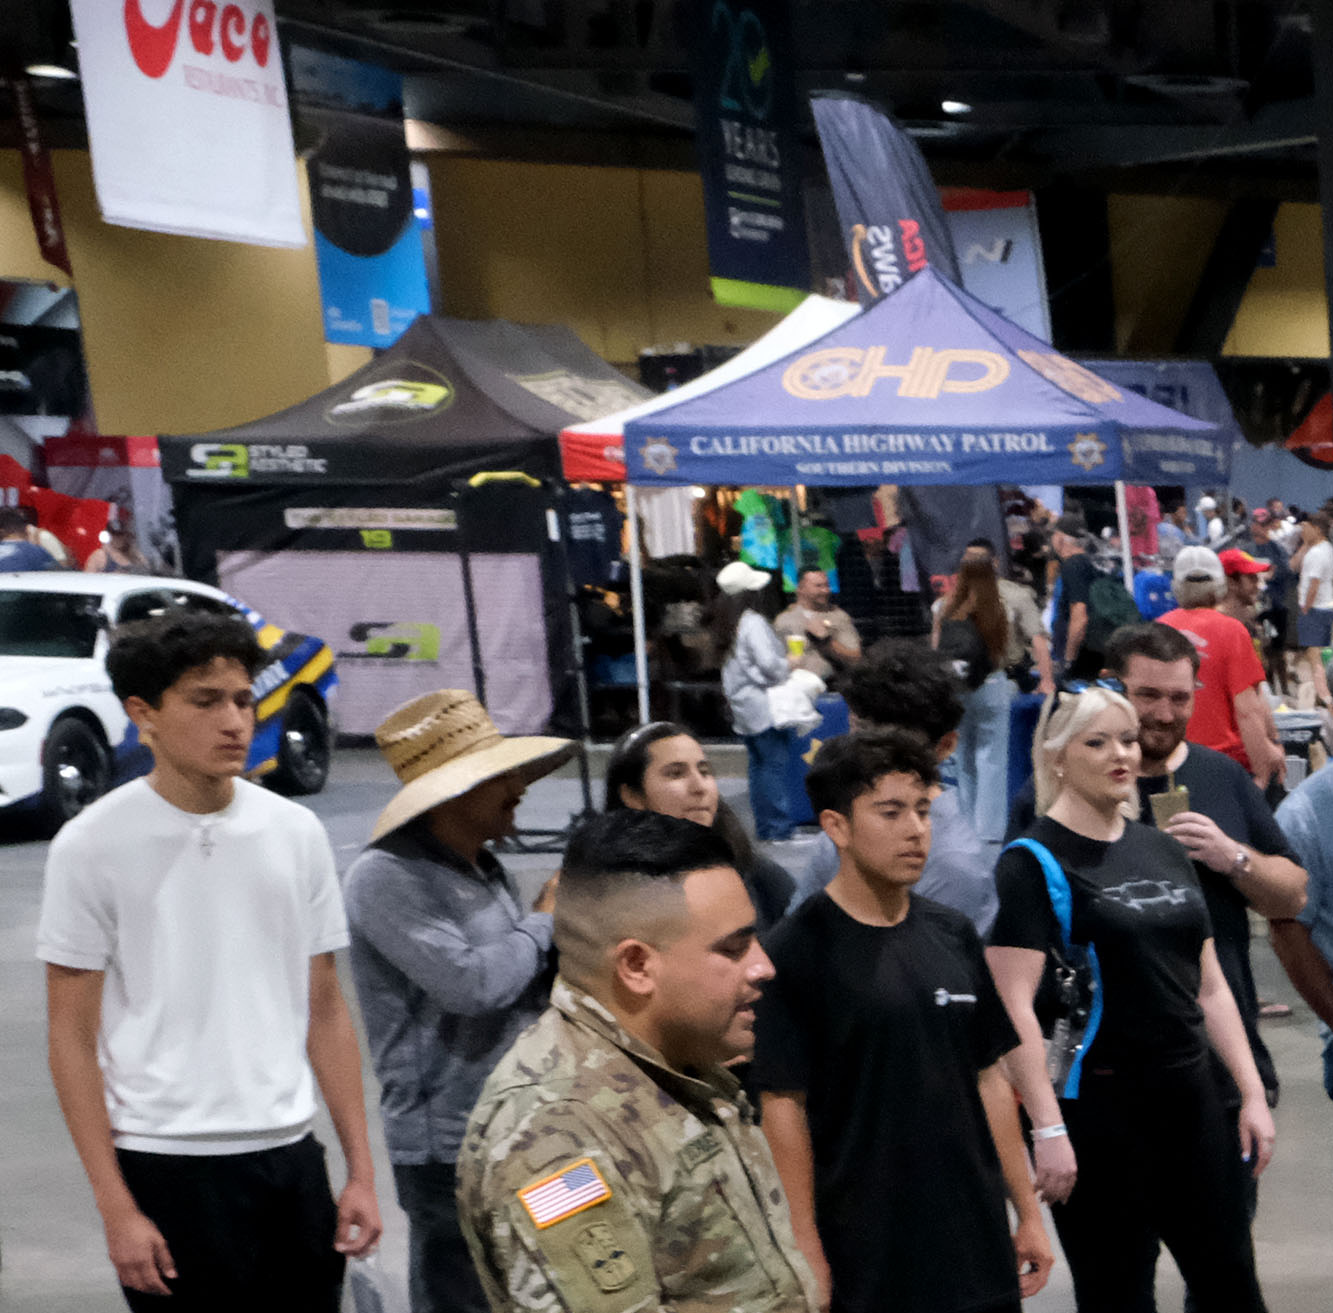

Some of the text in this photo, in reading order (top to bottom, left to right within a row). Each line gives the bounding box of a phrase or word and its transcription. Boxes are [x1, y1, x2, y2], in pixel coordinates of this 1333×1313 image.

[689, 431, 1056, 455] CALIFORNIA HIGHWAY PATROL
